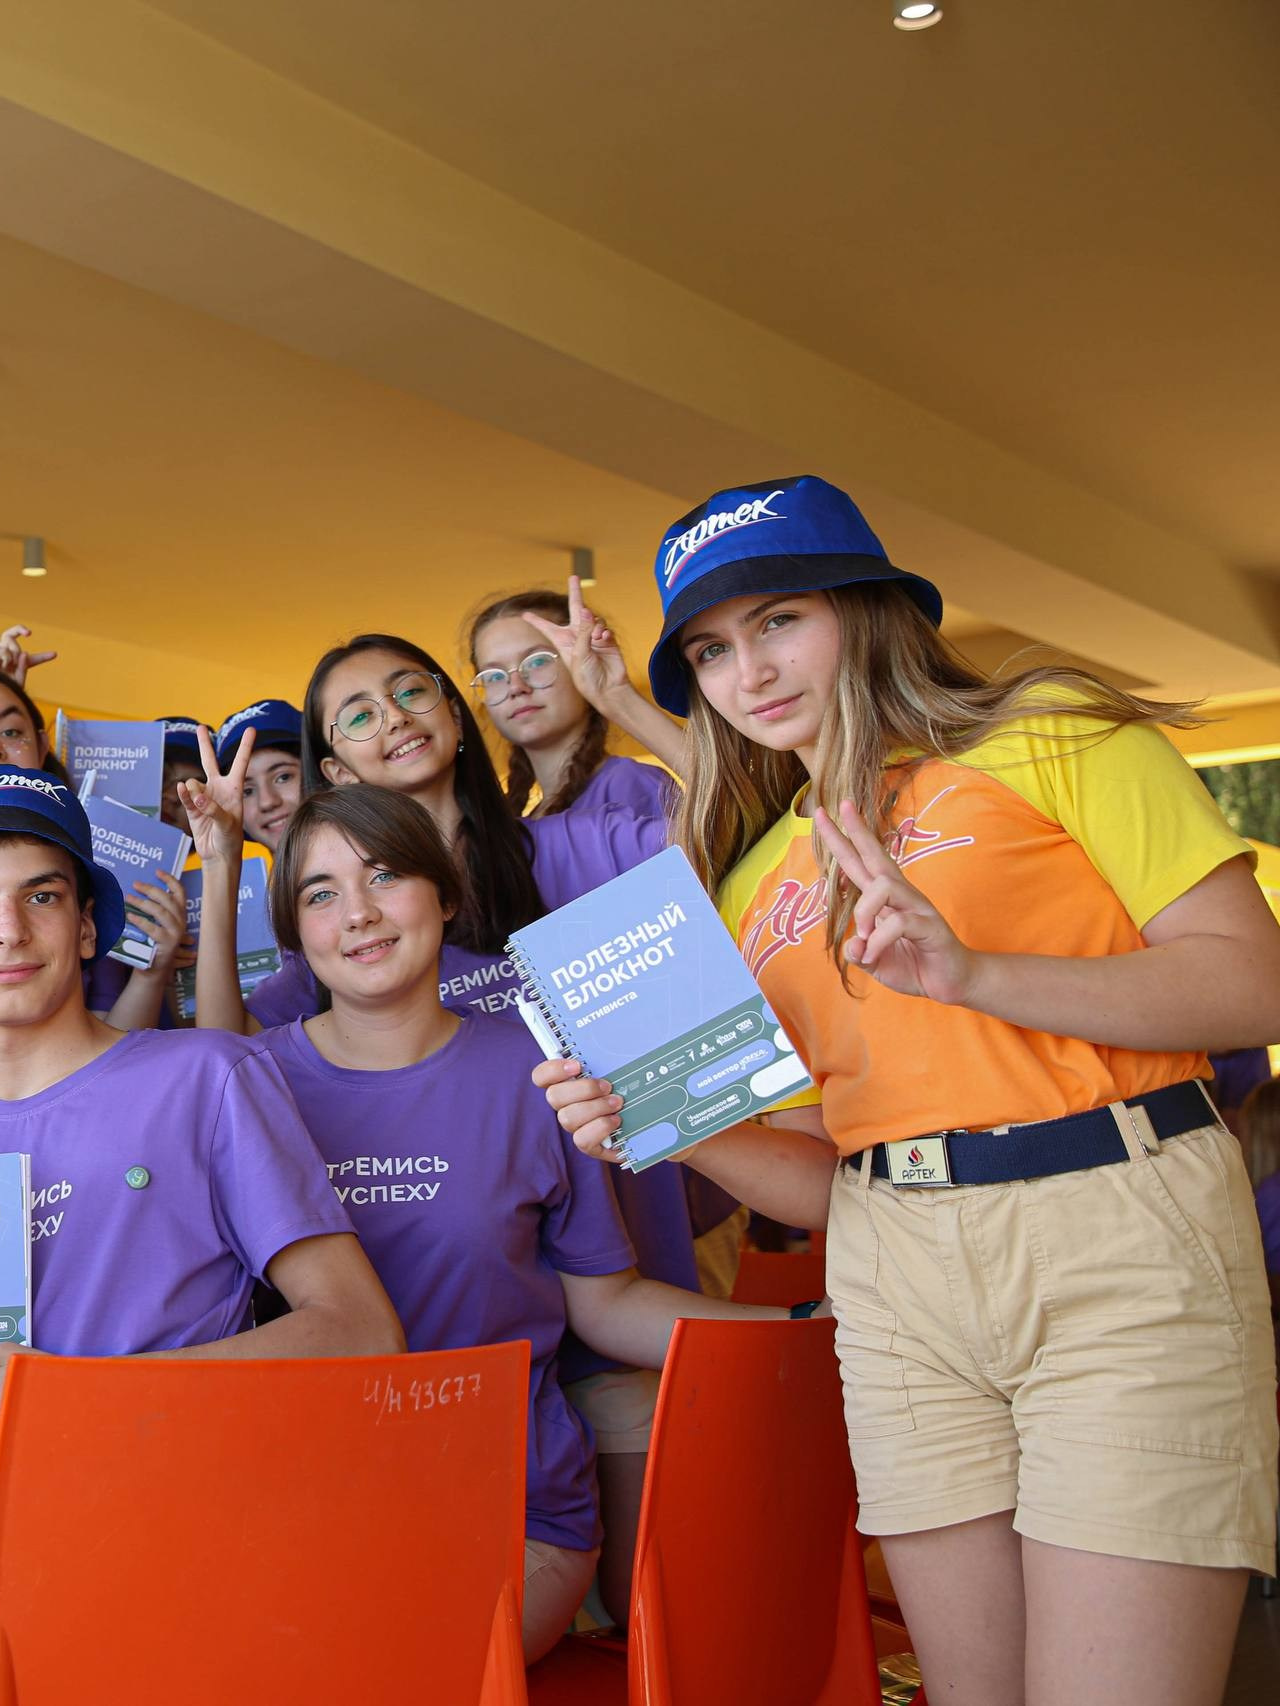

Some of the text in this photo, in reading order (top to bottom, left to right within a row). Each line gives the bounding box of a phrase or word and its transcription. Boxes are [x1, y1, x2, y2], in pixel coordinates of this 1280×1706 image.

[74, 746, 149, 759] ПОЛЕЗНЫЙ
[74, 759, 137, 771] БЛОКНОТ
[92, 839, 150, 869] ЛОКНОТ
[551, 902, 687, 989] ПОЛЕЗНЫЙ
[439, 960, 516, 1001] РЕМИС
[562, 937, 675, 1011] БЛОКНОТ
[576, 991, 638, 1029] активиста
[326, 1156, 449, 1179] ТРЕМИСЬ
[902, 1168, 937, 1180] АРТЕК
[334, 1182, 421, 1205] УСПЕХУ
